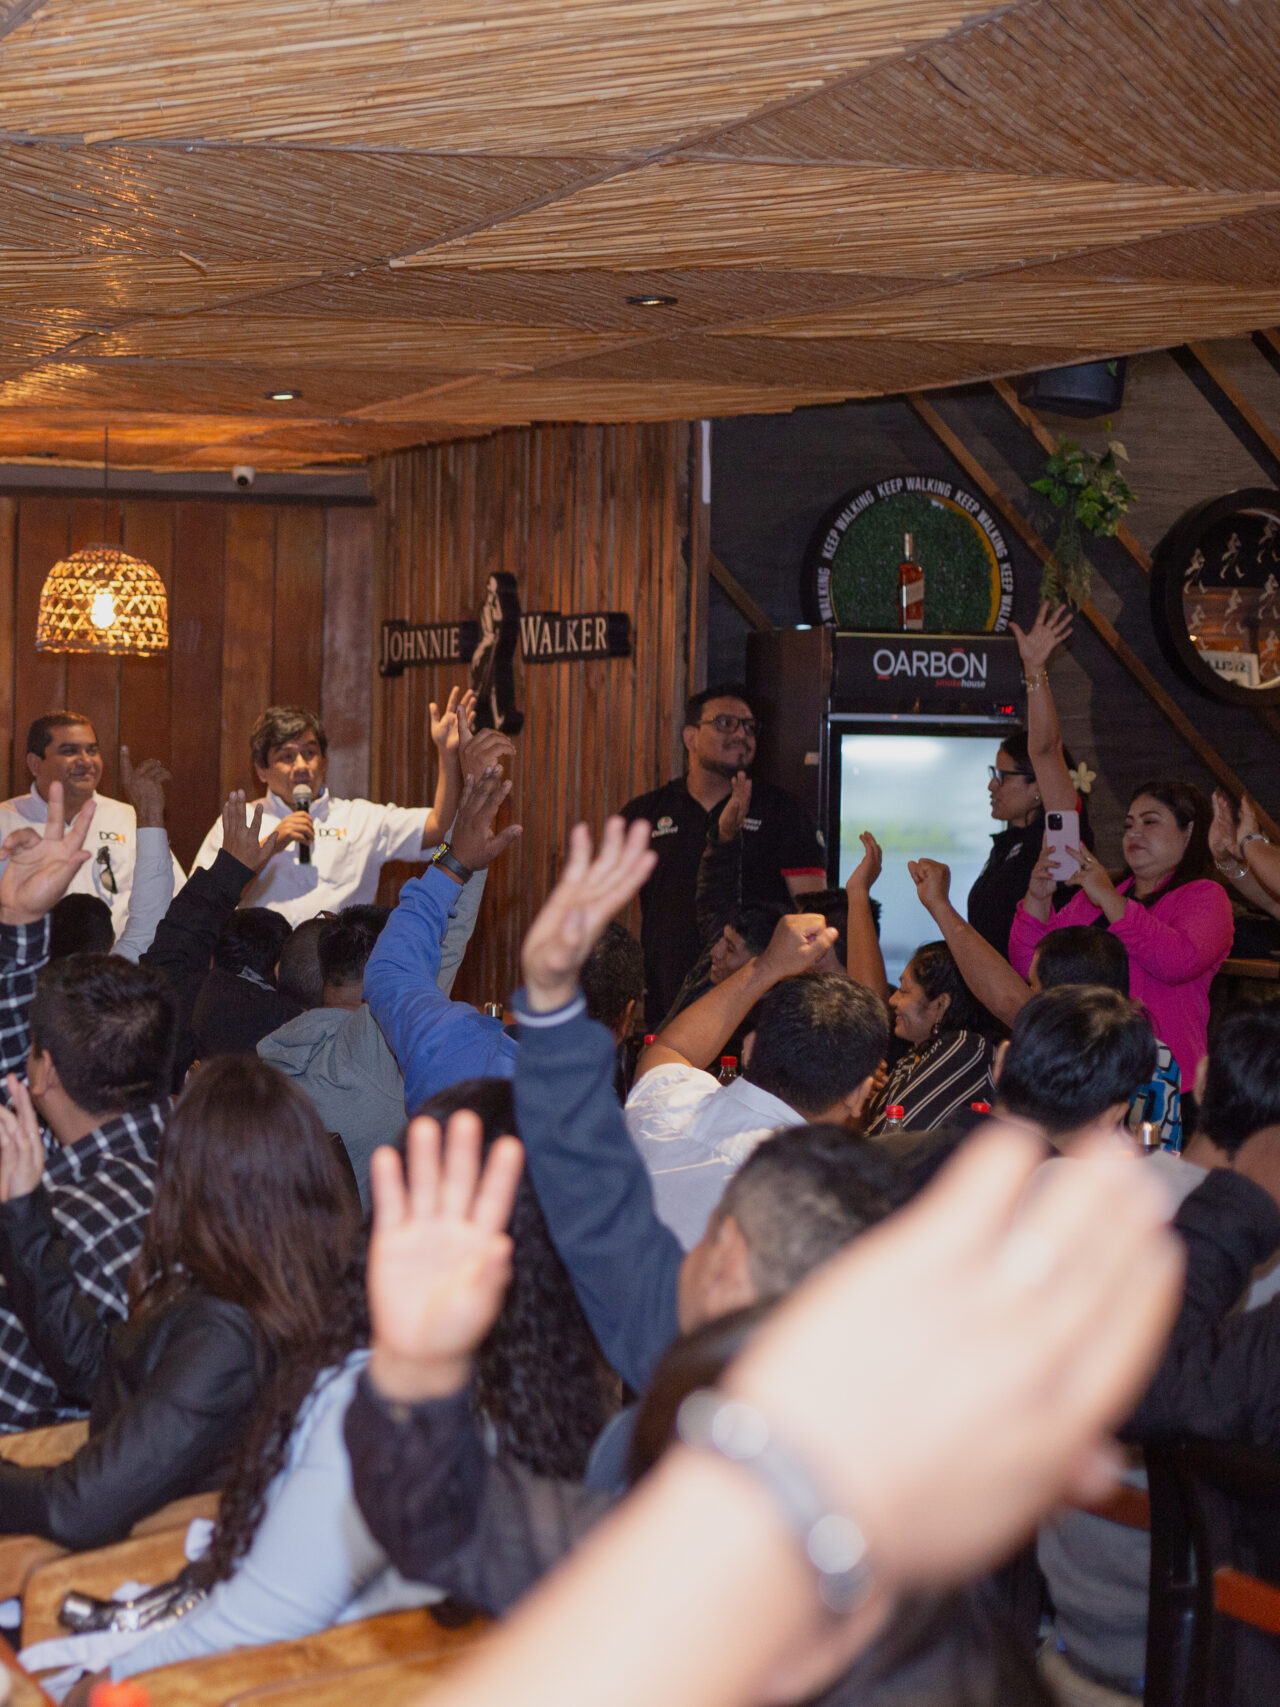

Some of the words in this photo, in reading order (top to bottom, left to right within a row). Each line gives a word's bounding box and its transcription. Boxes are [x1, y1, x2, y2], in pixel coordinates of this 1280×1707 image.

[877, 478, 903, 498] KEEP
[905, 476, 953, 497] WALKING
[821, 529, 840, 560] KEEP
[834, 489, 875, 532] WALKING
[954, 489, 980, 514] KEEP
[976, 510, 1008, 559] WALKING
[999, 562, 1014, 592] KEEP
[379, 626, 461, 673] JOHNNIE
[520, 615, 608, 656] WALKER
